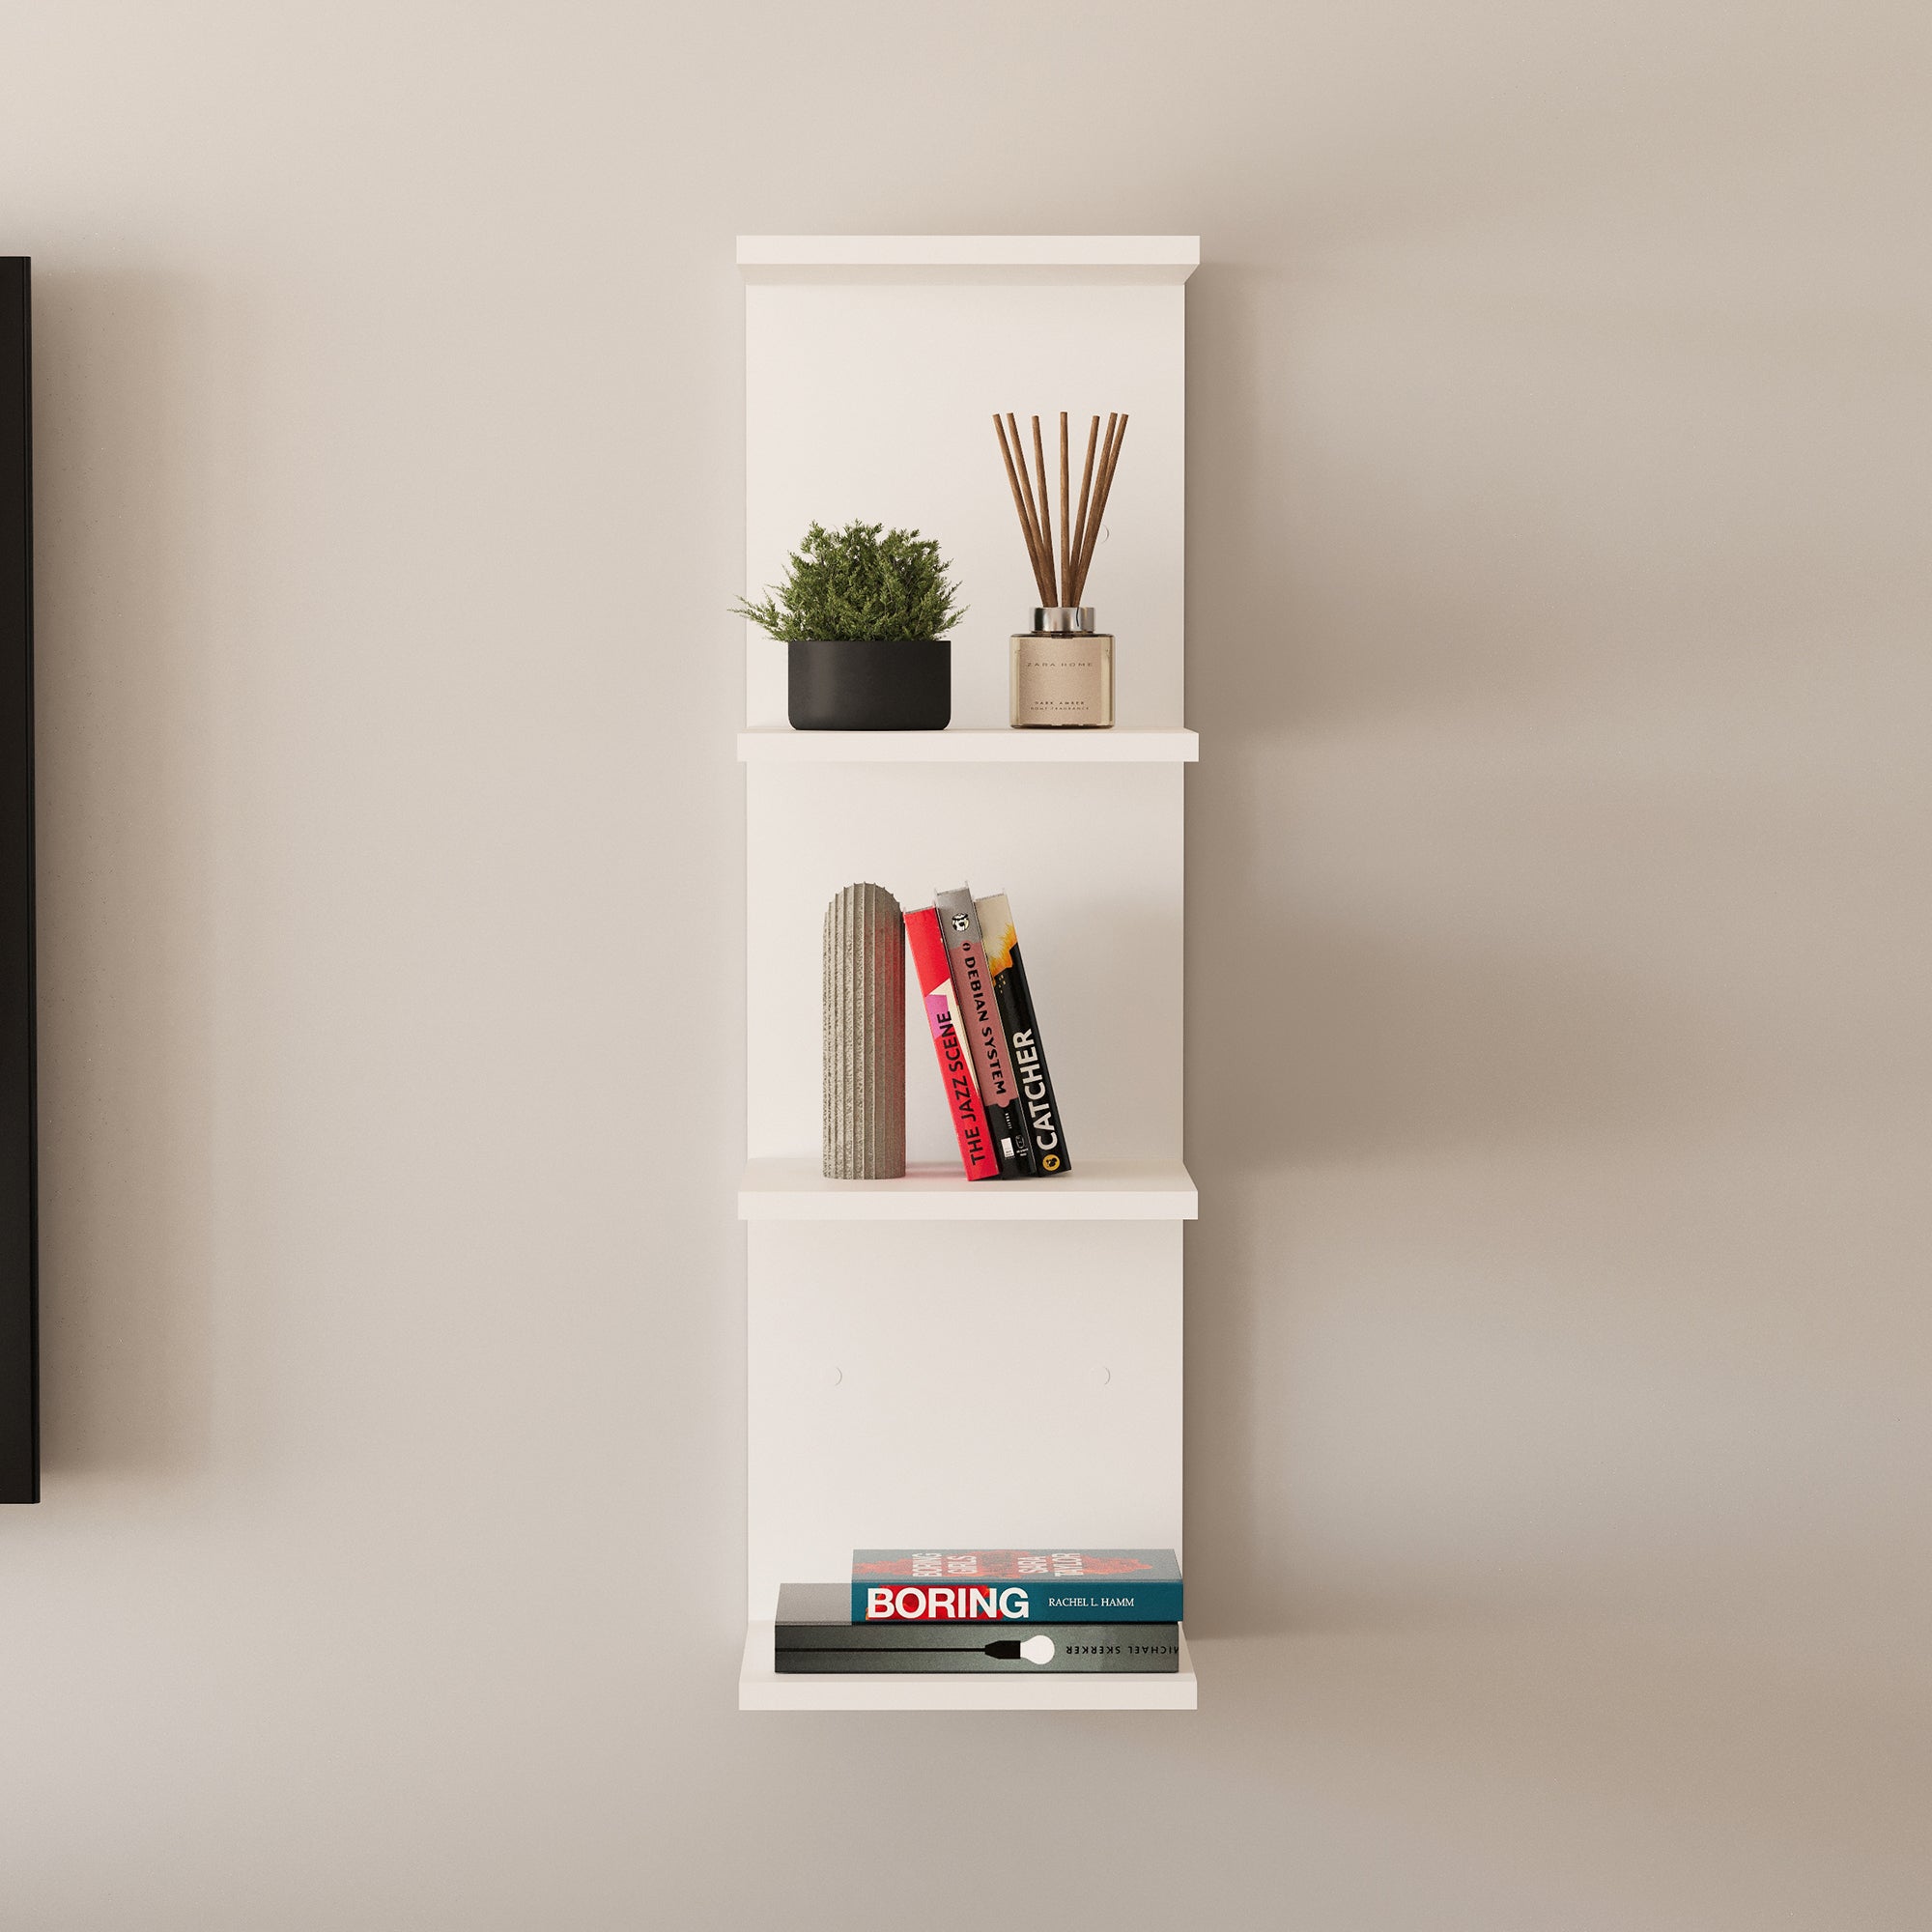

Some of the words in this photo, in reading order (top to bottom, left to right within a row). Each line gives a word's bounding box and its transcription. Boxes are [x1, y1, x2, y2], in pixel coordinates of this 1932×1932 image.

[964, 956, 989, 1022] DEBIAN
[981, 1027, 1007, 1095] SYSTEM
[937, 1010, 964, 1072] SCENE
[952, 1075, 977, 1122] JAZZ
[1012, 1028, 1058, 1151] CATCHER
[966, 1126, 986, 1166] THE
[912, 1552, 943, 1577] BORING
[947, 1555, 978, 1575] GIRLS
[1017, 1555, 1049, 1574] SARA
[1051, 1552, 1085, 1577] TAYLOR
[867, 1587, 1030, 1619] BORING
[1048, 1598, 1089, 1607] RACHEL
[1091, 1598, 1099, 1607] L.
[1100, 1598, 1135, 1607] HAMM
[1065, 1645, 1122, 1655] SKERKER
